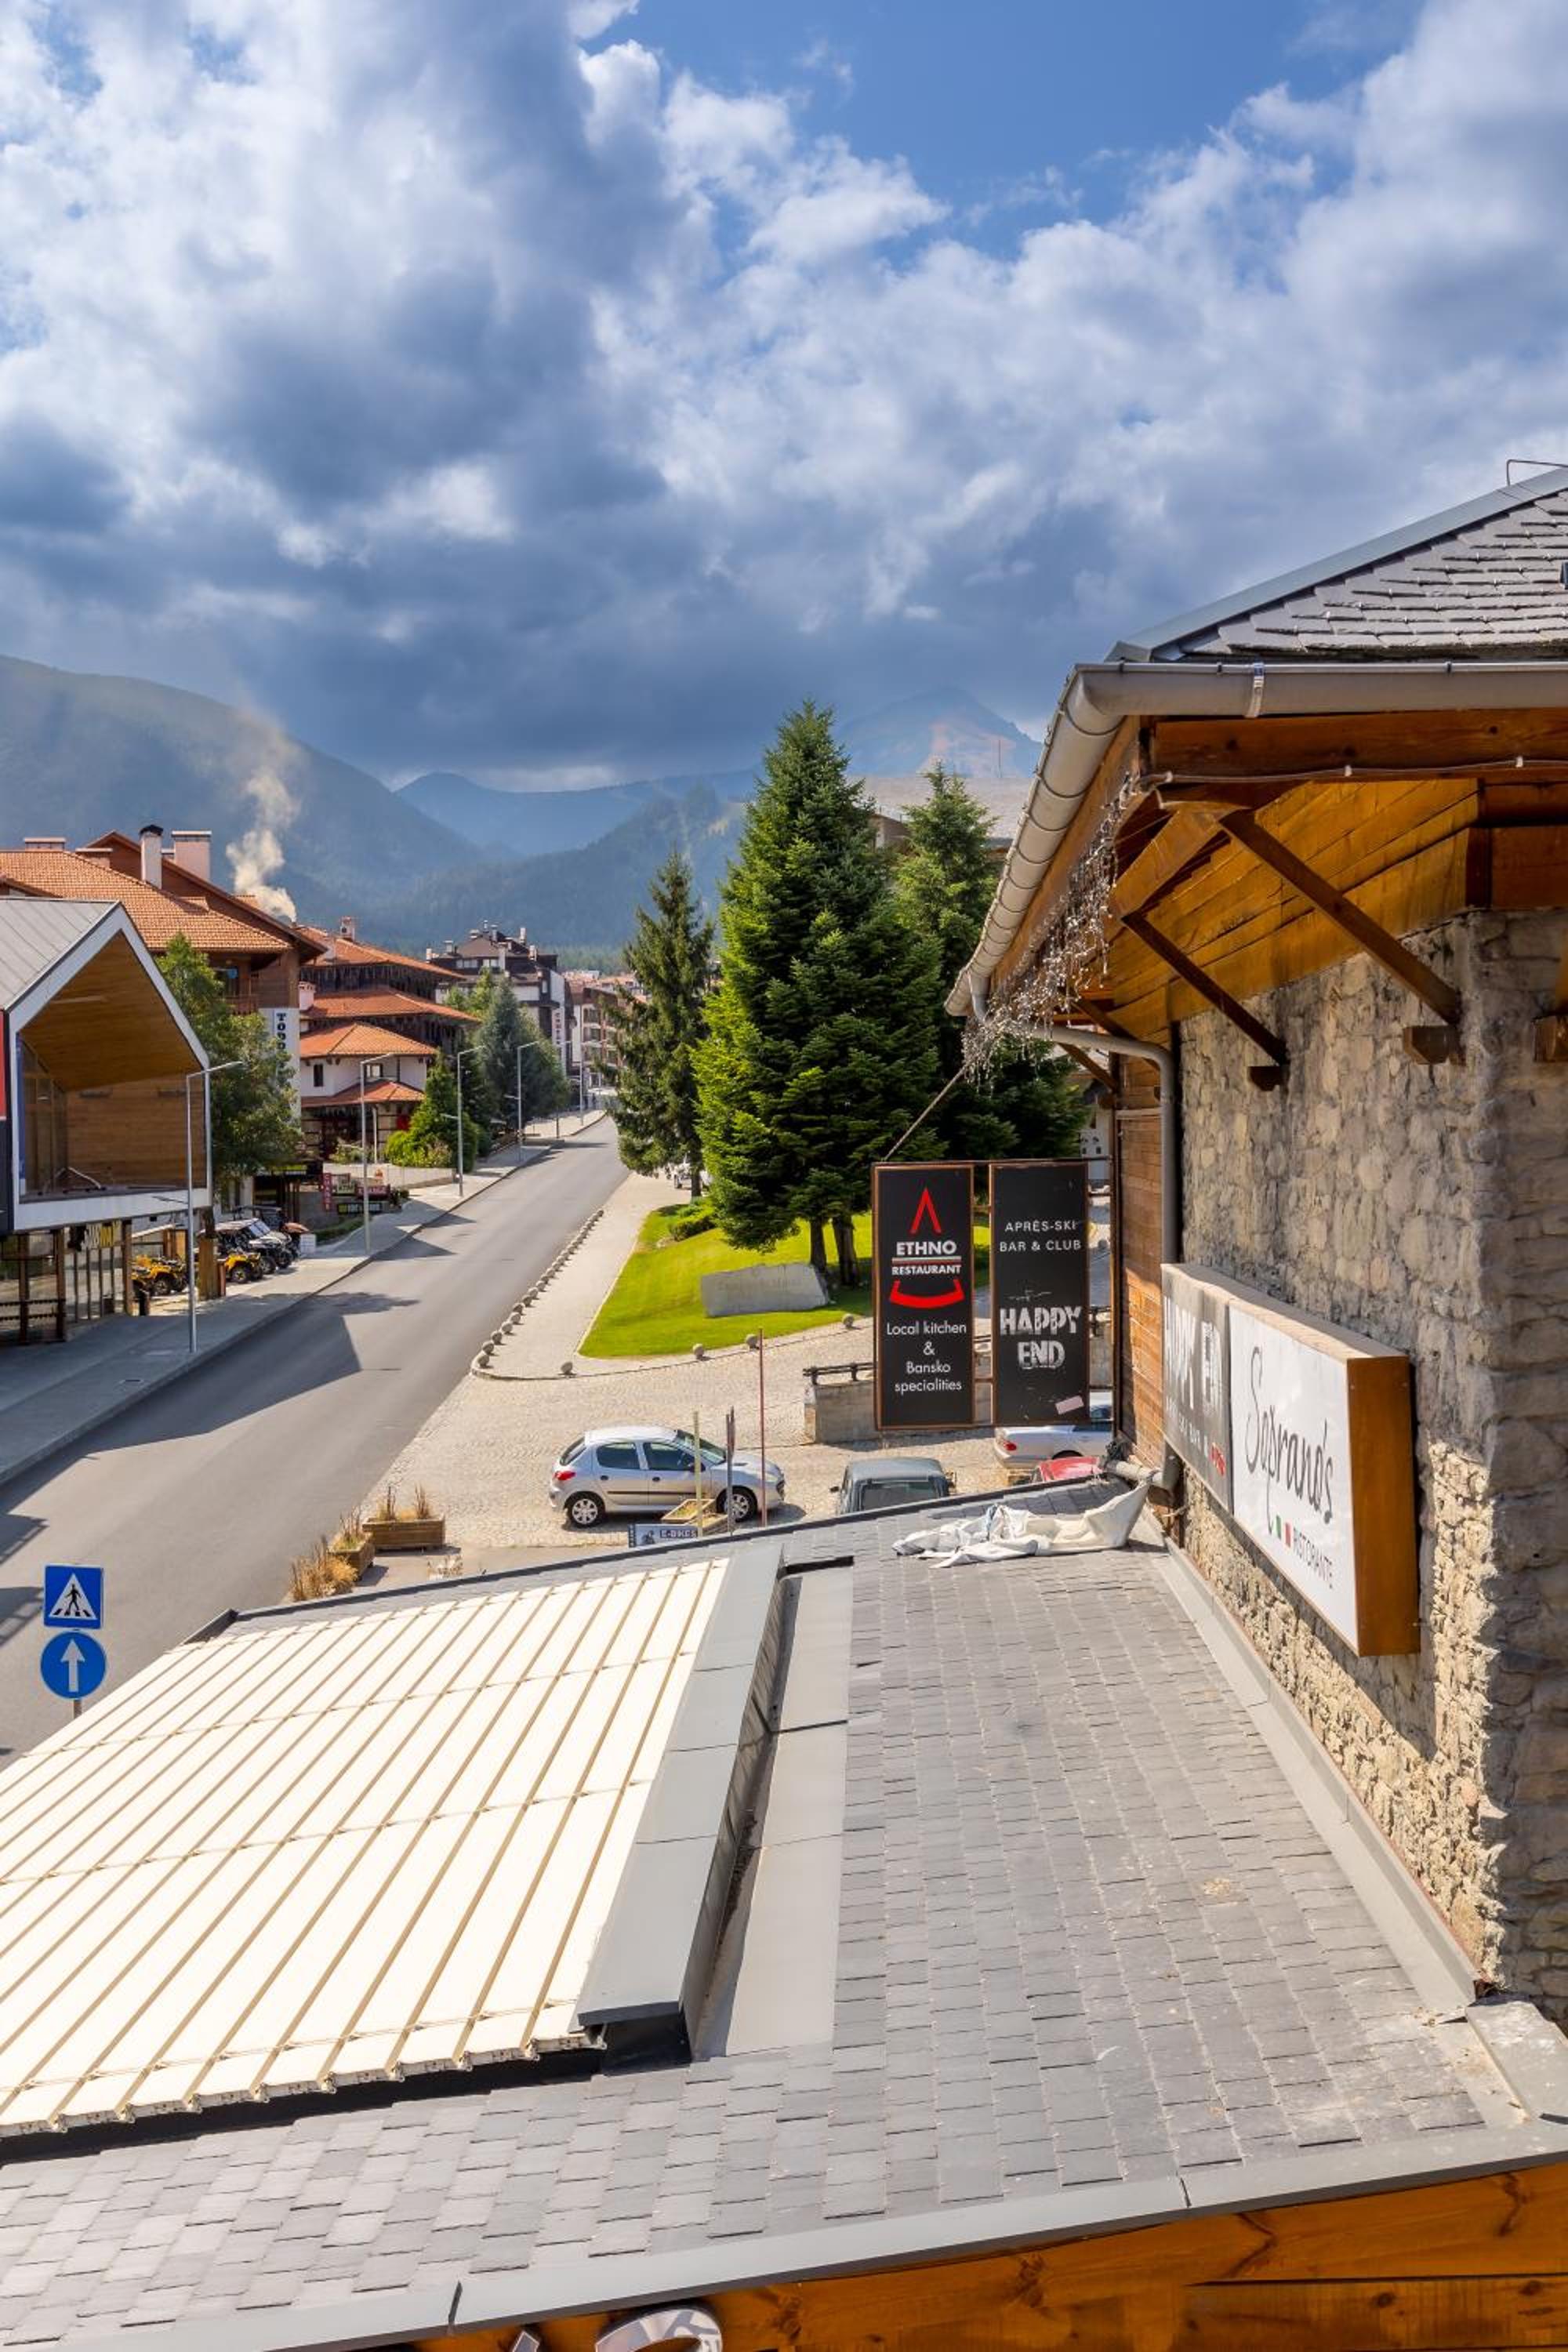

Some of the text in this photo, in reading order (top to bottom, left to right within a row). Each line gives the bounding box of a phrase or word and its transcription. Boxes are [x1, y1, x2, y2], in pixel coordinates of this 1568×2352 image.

[896, 1240, 956, 1255] ETHNO
[1000, 1239, 1082, 1252] BAR & CLUB
[892, 1265, 961, 1276] RESTAURANT
[887, 1320, 967, 1335] Local kitchen
[1000, 1305, 1083, 1336] HAPPY
[923, 1341, 935, 1356] &
[1018, 1341, 1065, 1370] END
[906, 1359, 951, 1374] Bansko
[895, 1379, 962, 1396] specialities
[1245, 1346, 1334, 1537] Soprano's
[1292, 1527, 1334, 1590] RISTORANTE
